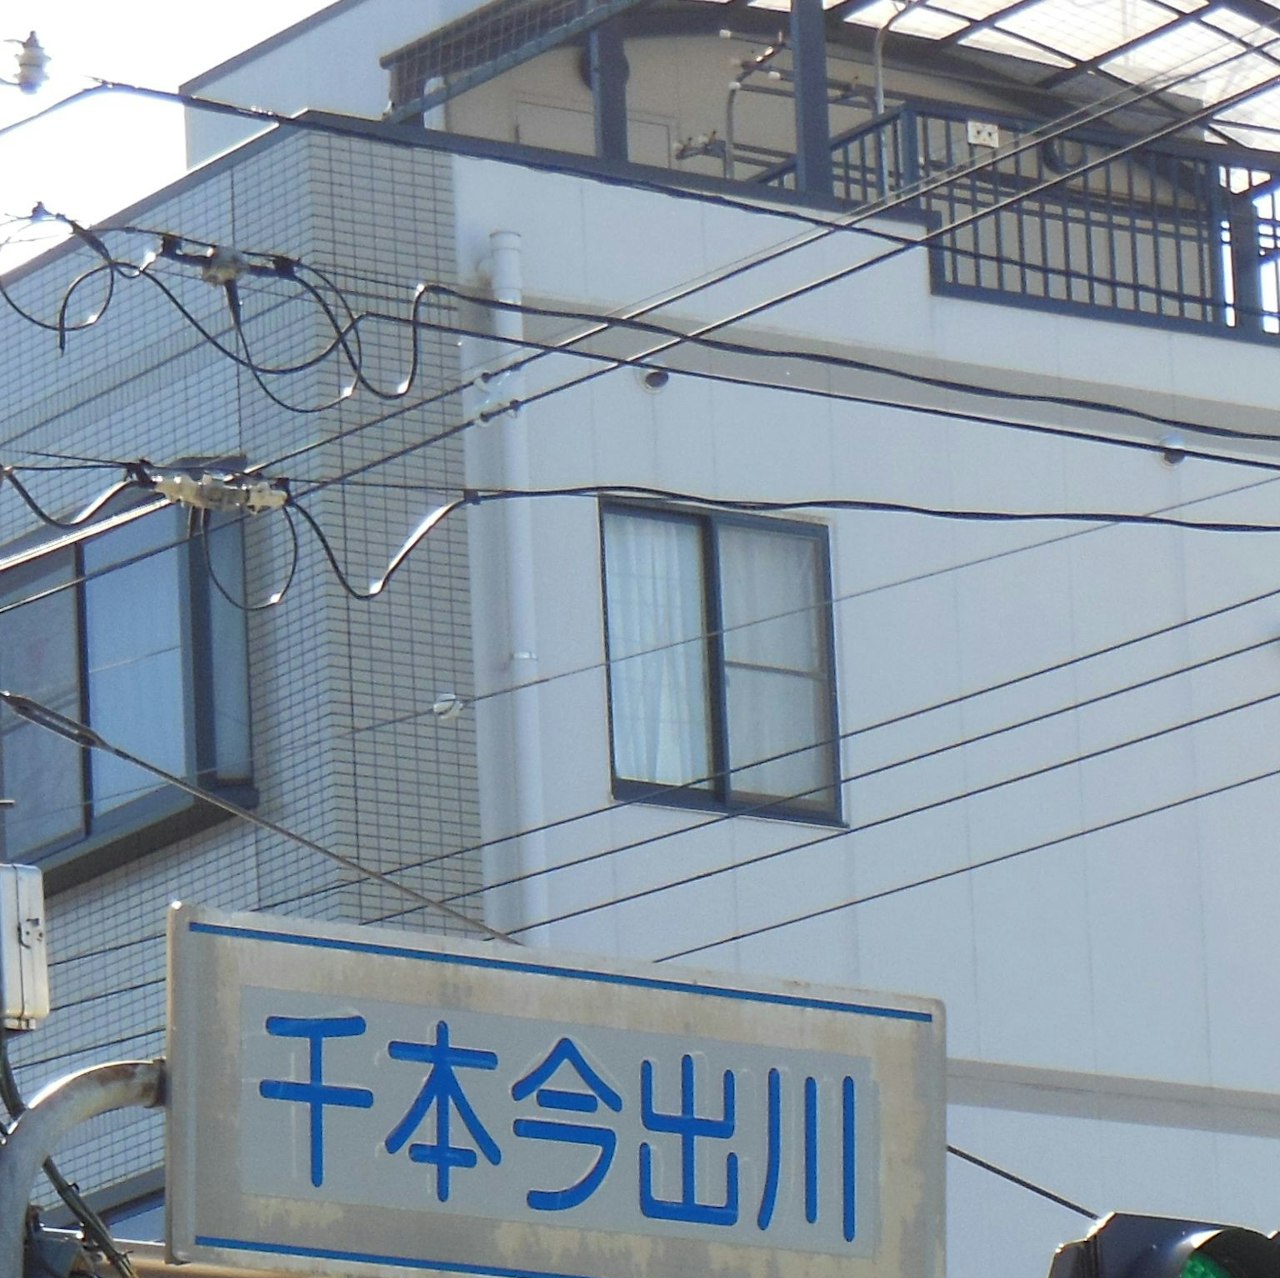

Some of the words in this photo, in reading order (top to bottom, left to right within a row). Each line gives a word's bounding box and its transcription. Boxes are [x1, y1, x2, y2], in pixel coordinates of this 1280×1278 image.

[259, 1015, 856, 1243] 千本今出川
